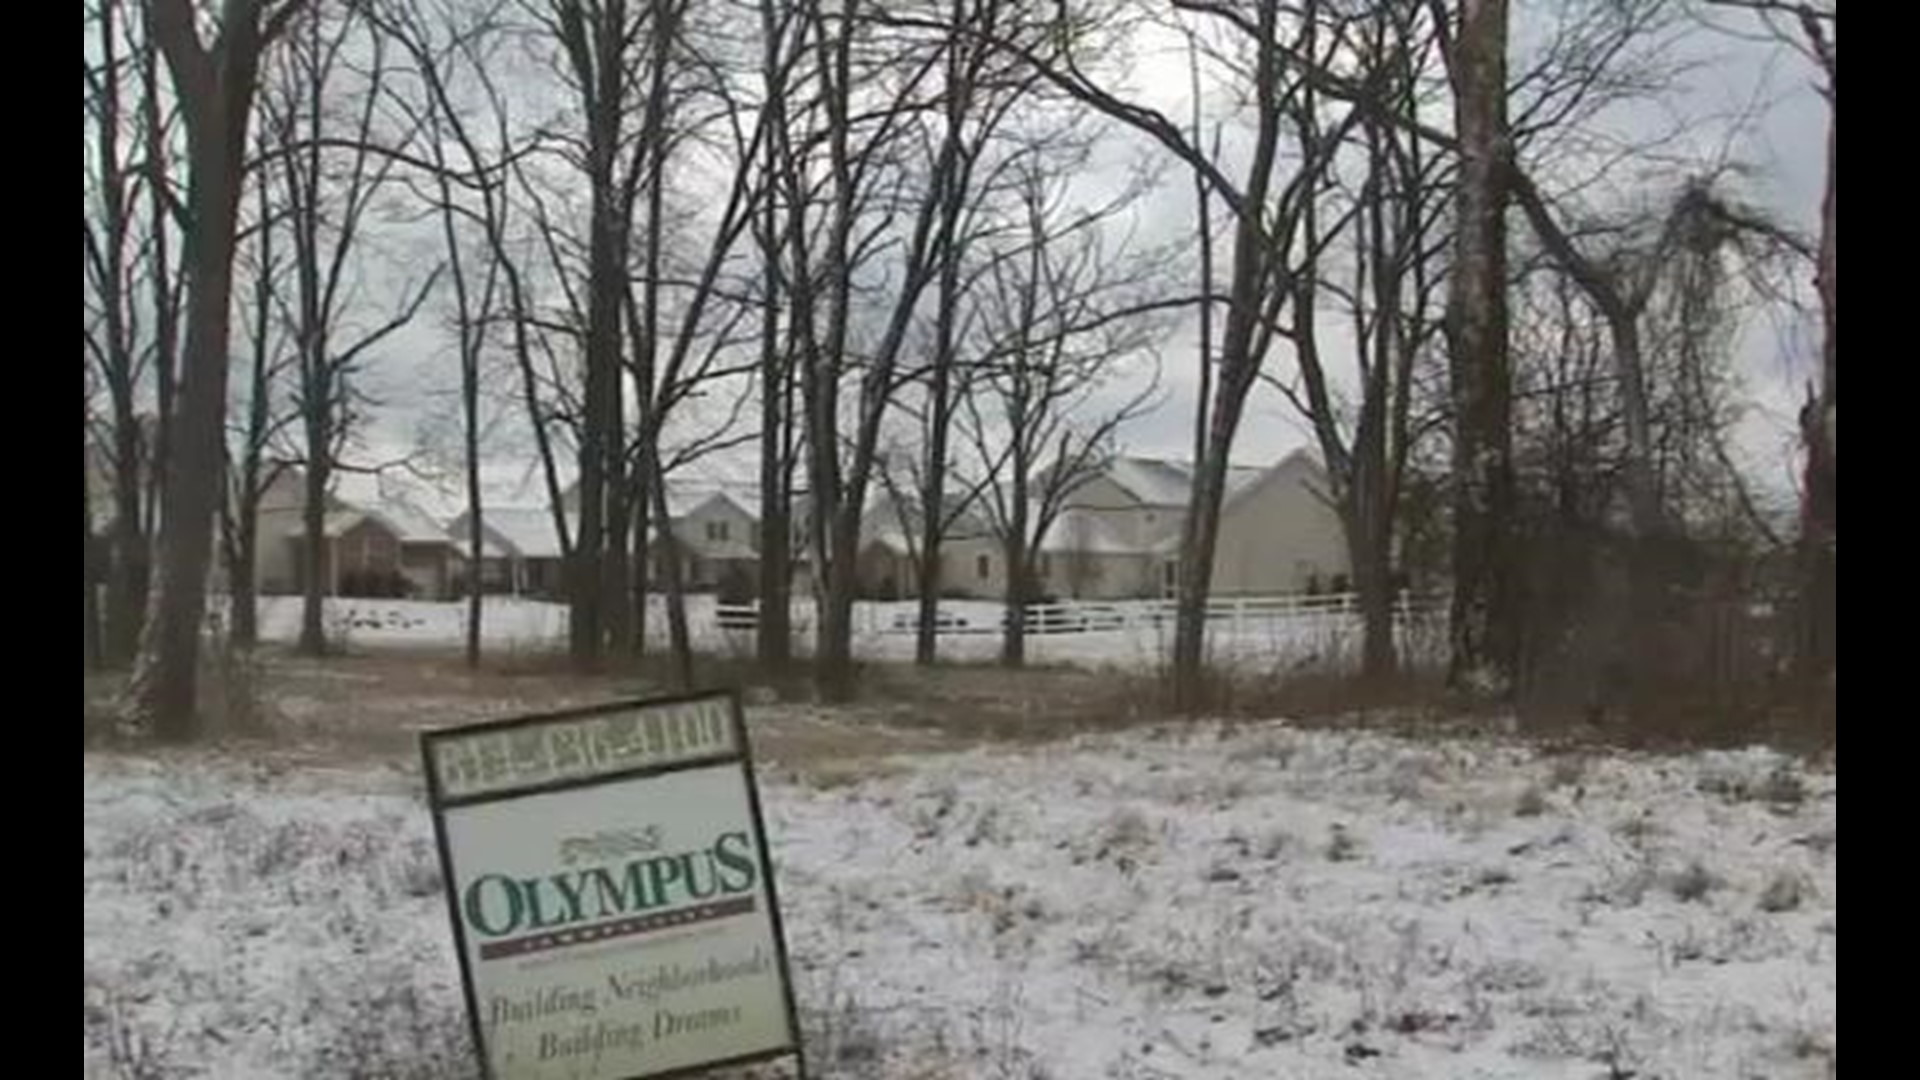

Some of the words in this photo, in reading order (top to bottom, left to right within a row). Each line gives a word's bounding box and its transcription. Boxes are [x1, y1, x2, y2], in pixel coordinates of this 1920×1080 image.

[464, 831, 757, 937] OLYMPUS
[488, 984, 599, 1027] Building
[538, 1018, 647, 1061] Building
[653, 1005, 742, 1040] Dreams
